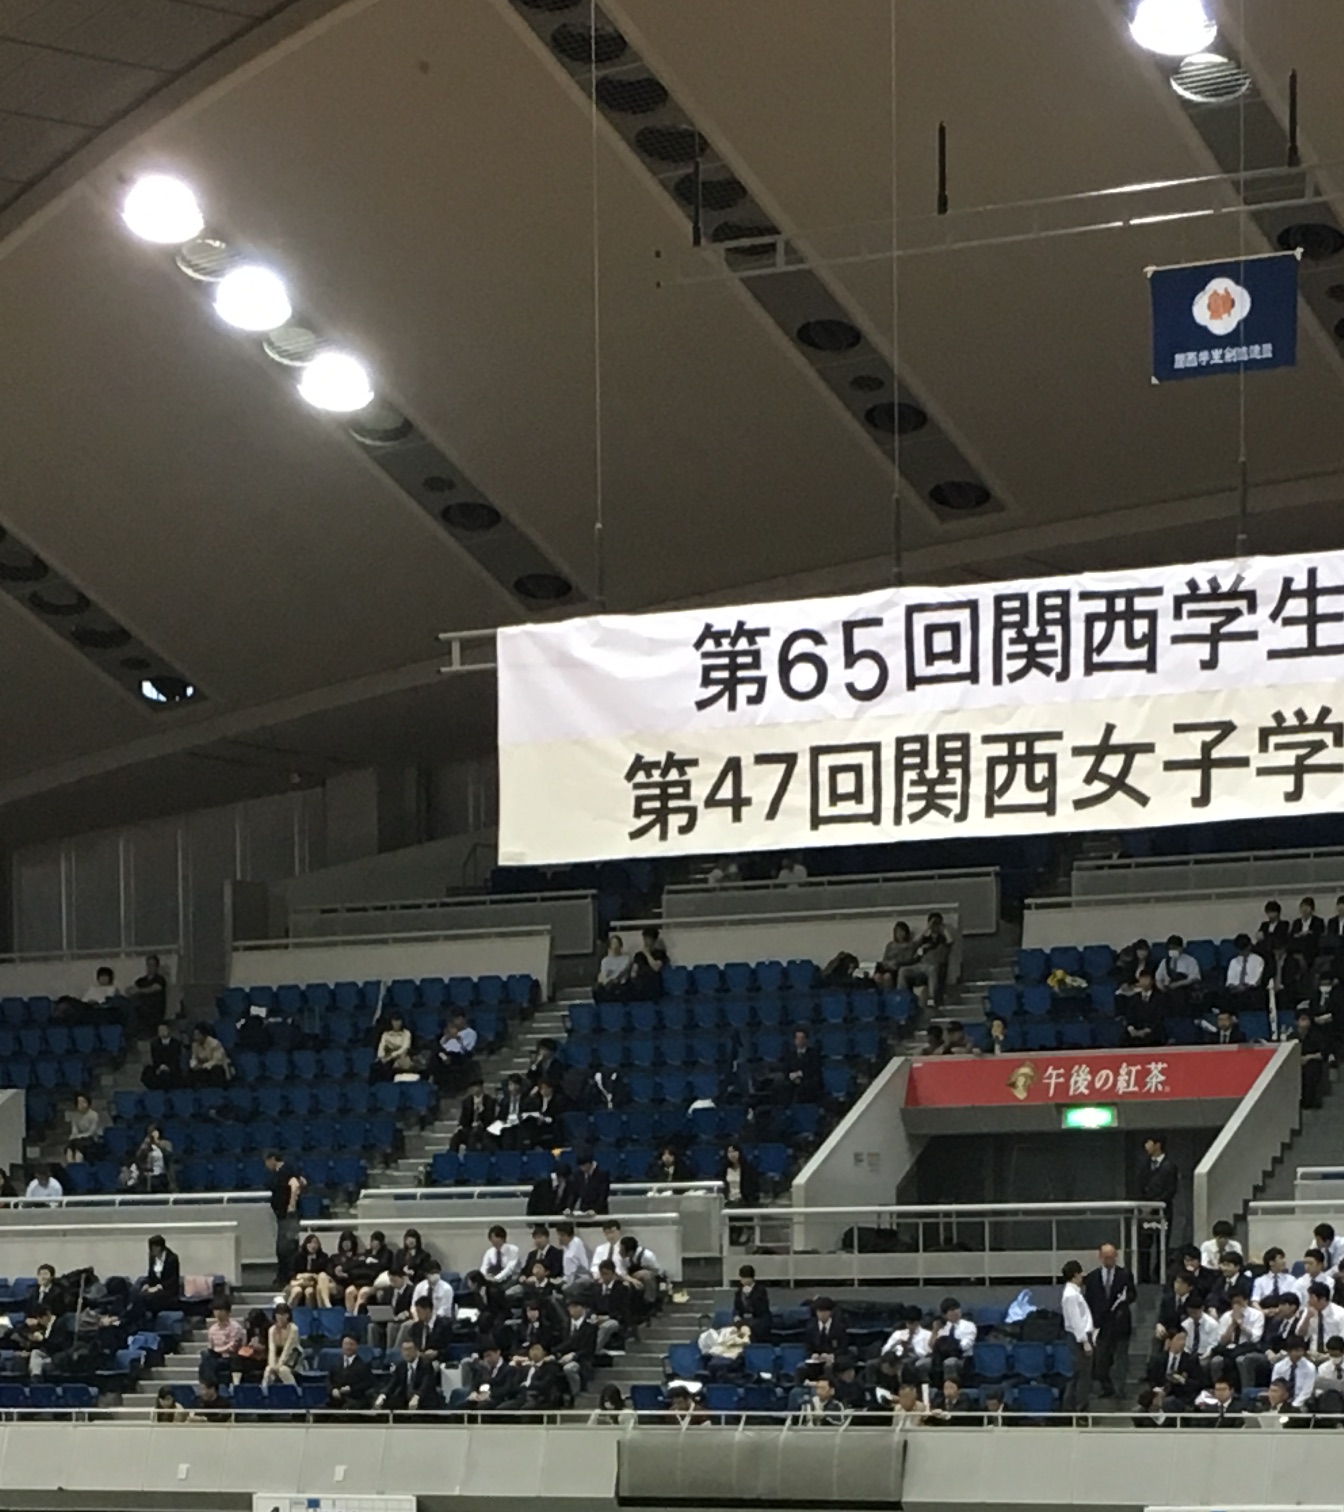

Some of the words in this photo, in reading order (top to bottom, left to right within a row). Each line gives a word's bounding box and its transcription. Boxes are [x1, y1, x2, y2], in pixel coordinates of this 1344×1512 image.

[1041, 1061, 1169, 1097] 午後の紅茶
